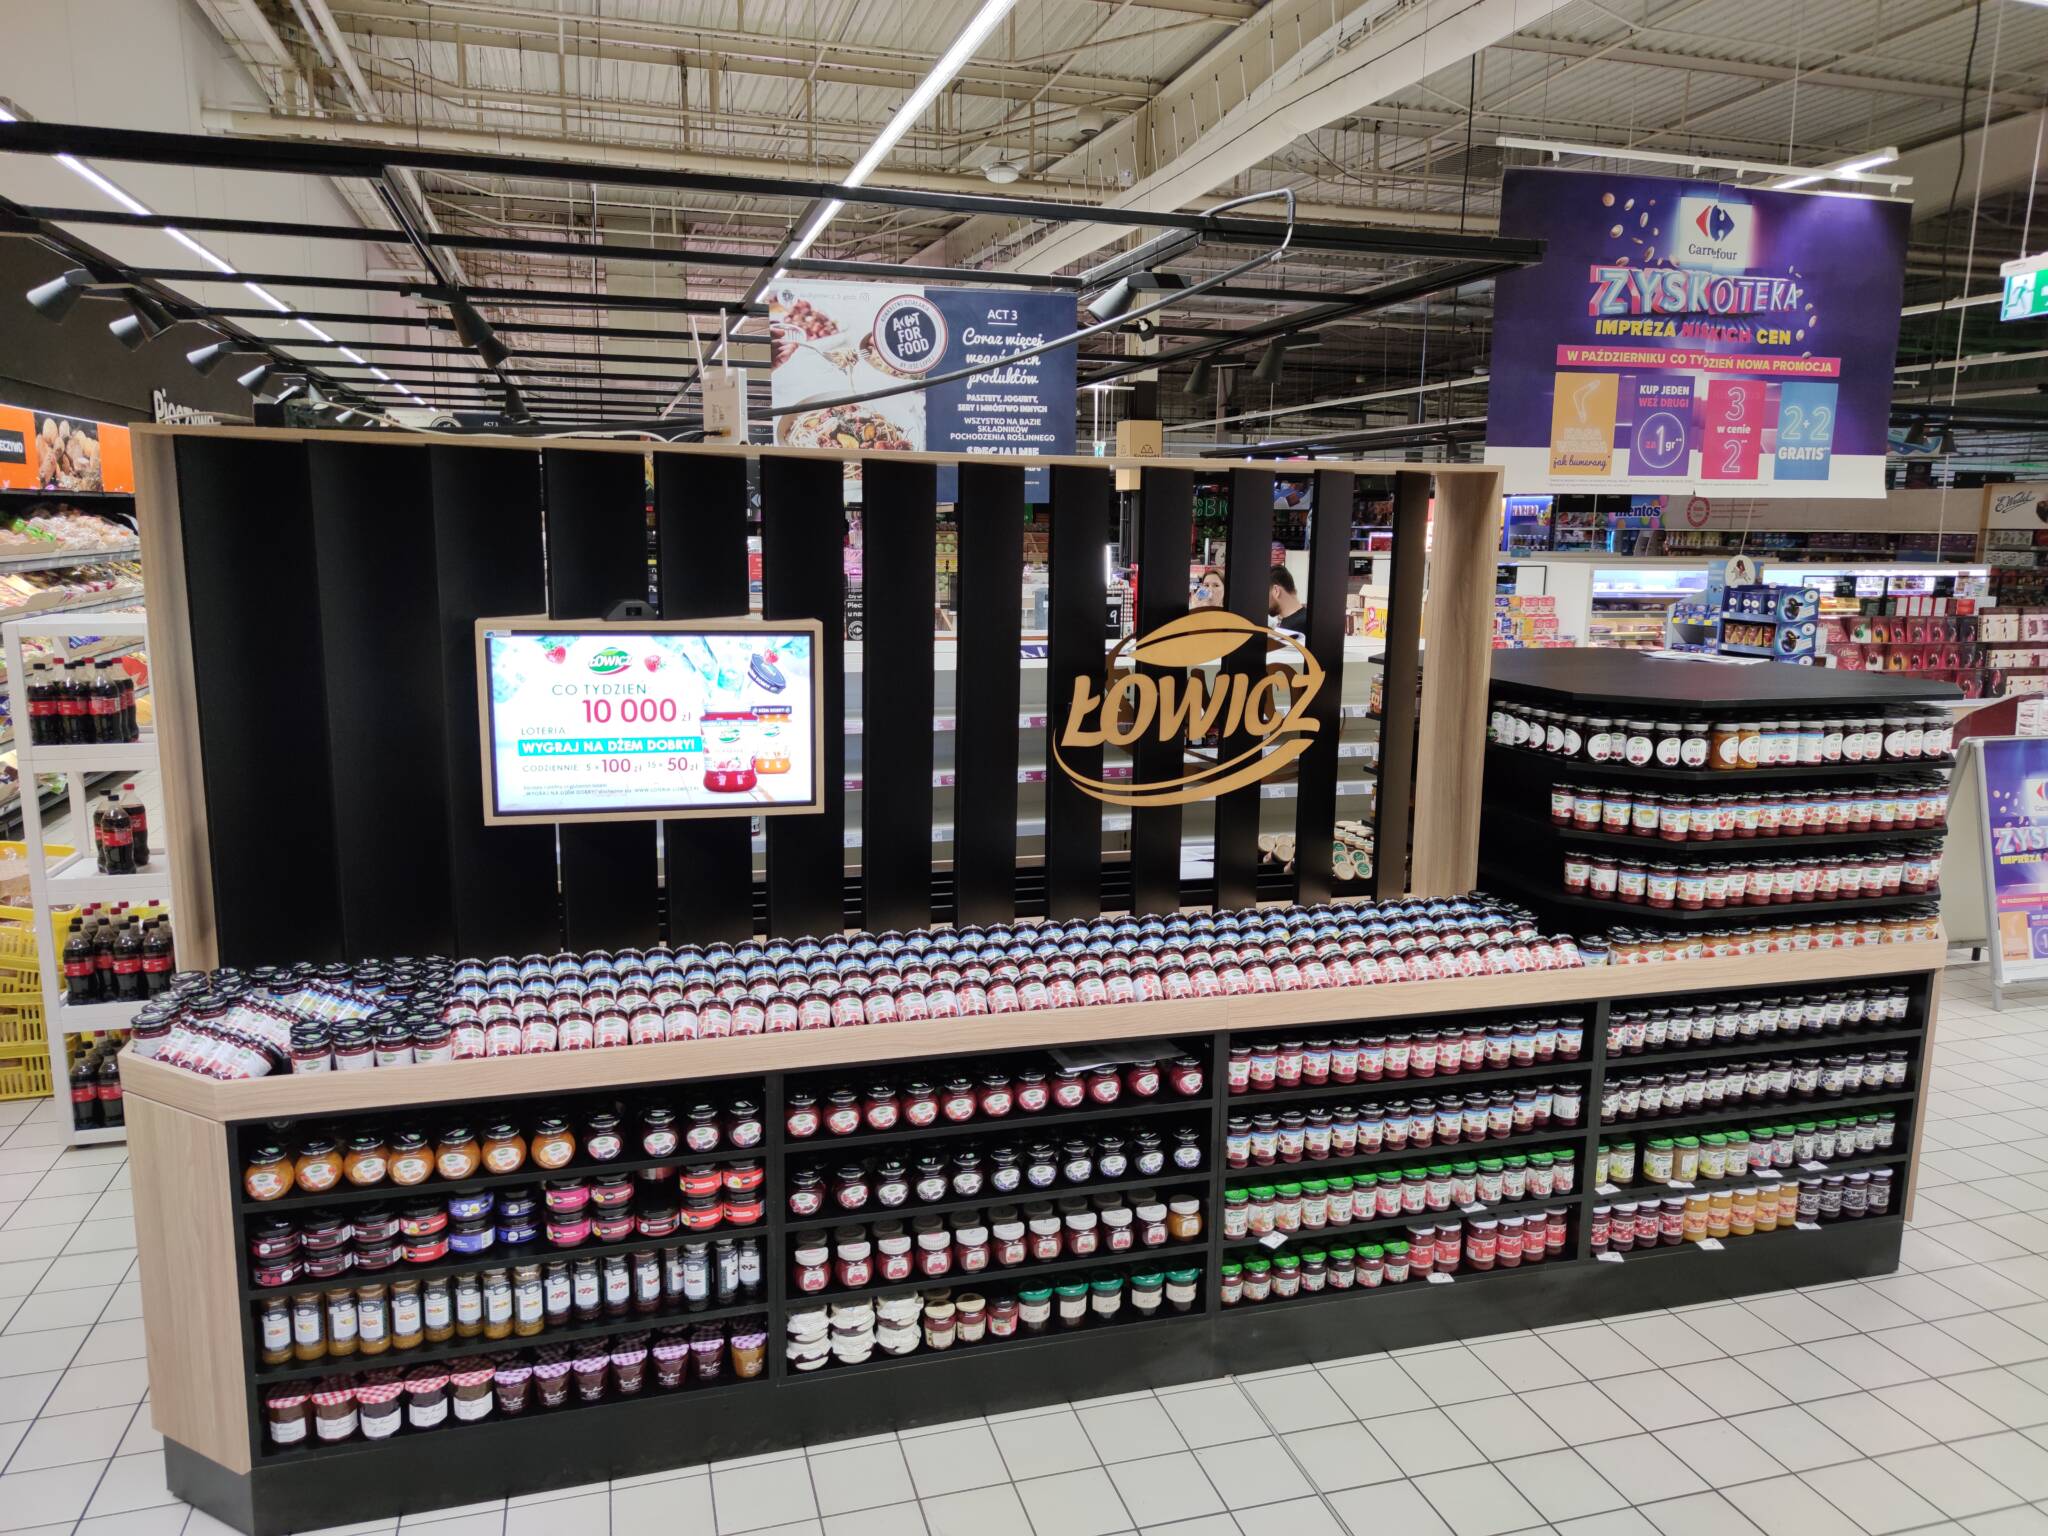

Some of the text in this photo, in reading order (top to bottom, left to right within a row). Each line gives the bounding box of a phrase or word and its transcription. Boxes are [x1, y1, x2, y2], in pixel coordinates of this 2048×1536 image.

[1688, 243, 1738, 260] Carrefour
[1589, 265, 1798, 316] ZYSKOTEKA
[987, 309, 1018, 320] ACT 3
[898, 326, 922, 343] FOR
[962, 327, 1045, 349] Coraz więcej
[1595, 320, 1677, 337] IMPREZA
[1757, 329, 1791, 345] CEN
[897, 338, 930, 357] FOOD
[1567, 348, 1832, 373] W PAŹDZIERNIKU CO TYDZIEŃ NOWA PROMOCJA
[966, 367, 1039, 390] produktów
[1640, 385, 1690, 395] KUP JEDEN
[1020, 405, 1047, 413] INNYCH
[1638, 397, 1689, 408] WEŹ DRUGI
[1725, 387, 1746, 421] 3
[964, 417, 1005, 425] WSZYSTKO
[1019, 418, 1041, 426] BAZIE
[977, 425, 1028, 433] SKŁADNIKÓW
[1717, 424, 1751, 434] w cenie
[950, 433, 1055, 442] POCHODZENIA ROŚLINNEGO
[1656, 425, 1665, 456] 1
[1553, 455, 1567, 468] jak
[552, 684, 578, 696] CO
[582, 699, 611, 723] 10
[620, 698, 677, 723] 000
[1060, 672, 1322, 748] ŁOWICZ
[521, 726, 566, 736] LOTERIA
[521, 738, 696, 754] WYGRAJ NA DŻEM DOBRY!
[522, 764, 578, 773] CODZIENNIE
[586, 763, 591, 771] 5
[602, 758, 631, 773] 100
[667, 757, 688, 771] 50
[1993, 827, 2048, 854] ZYS
